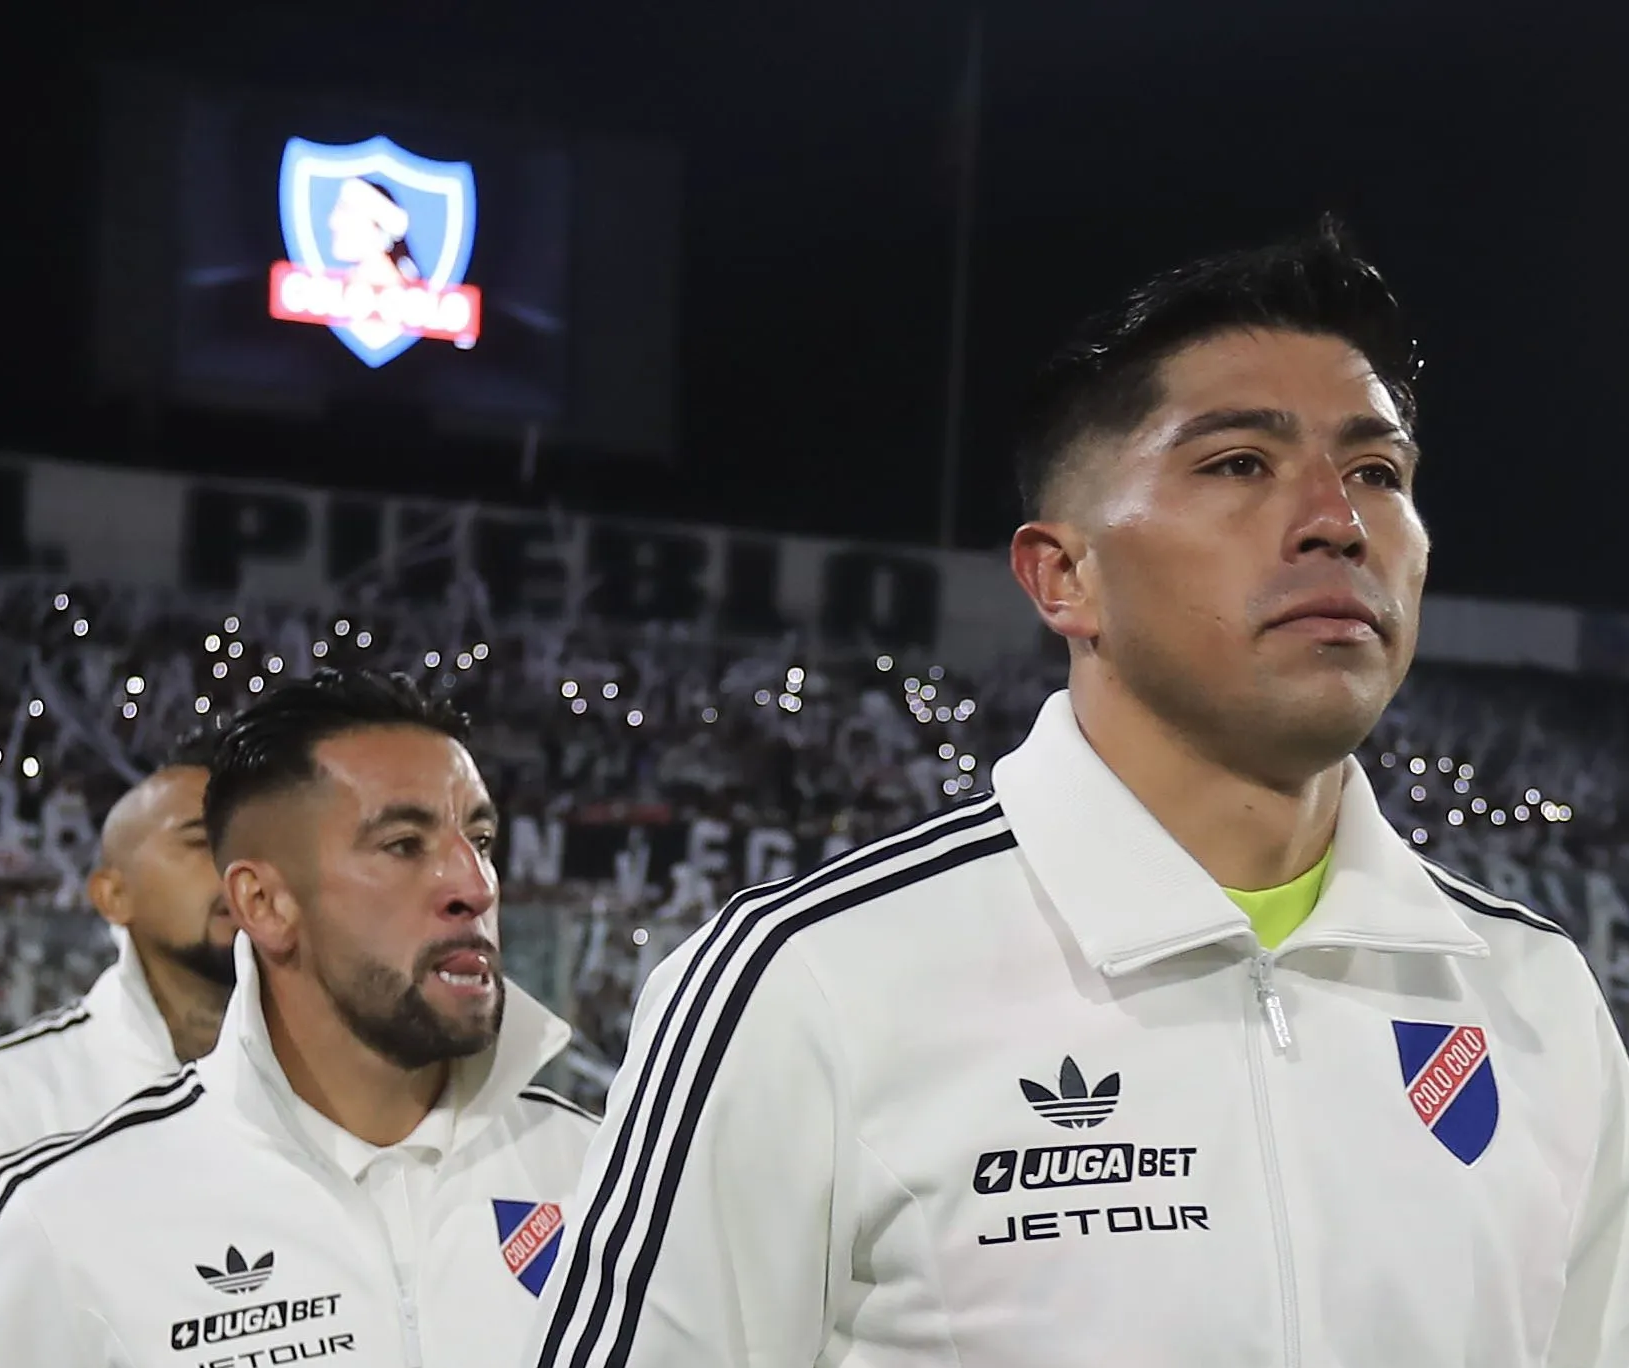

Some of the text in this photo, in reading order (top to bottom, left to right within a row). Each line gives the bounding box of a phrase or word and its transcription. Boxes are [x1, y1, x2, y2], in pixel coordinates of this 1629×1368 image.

[1412, 1029, 1482, 1115] COLO COLO
[977, 1206, 1211, 1245] JETOUR
